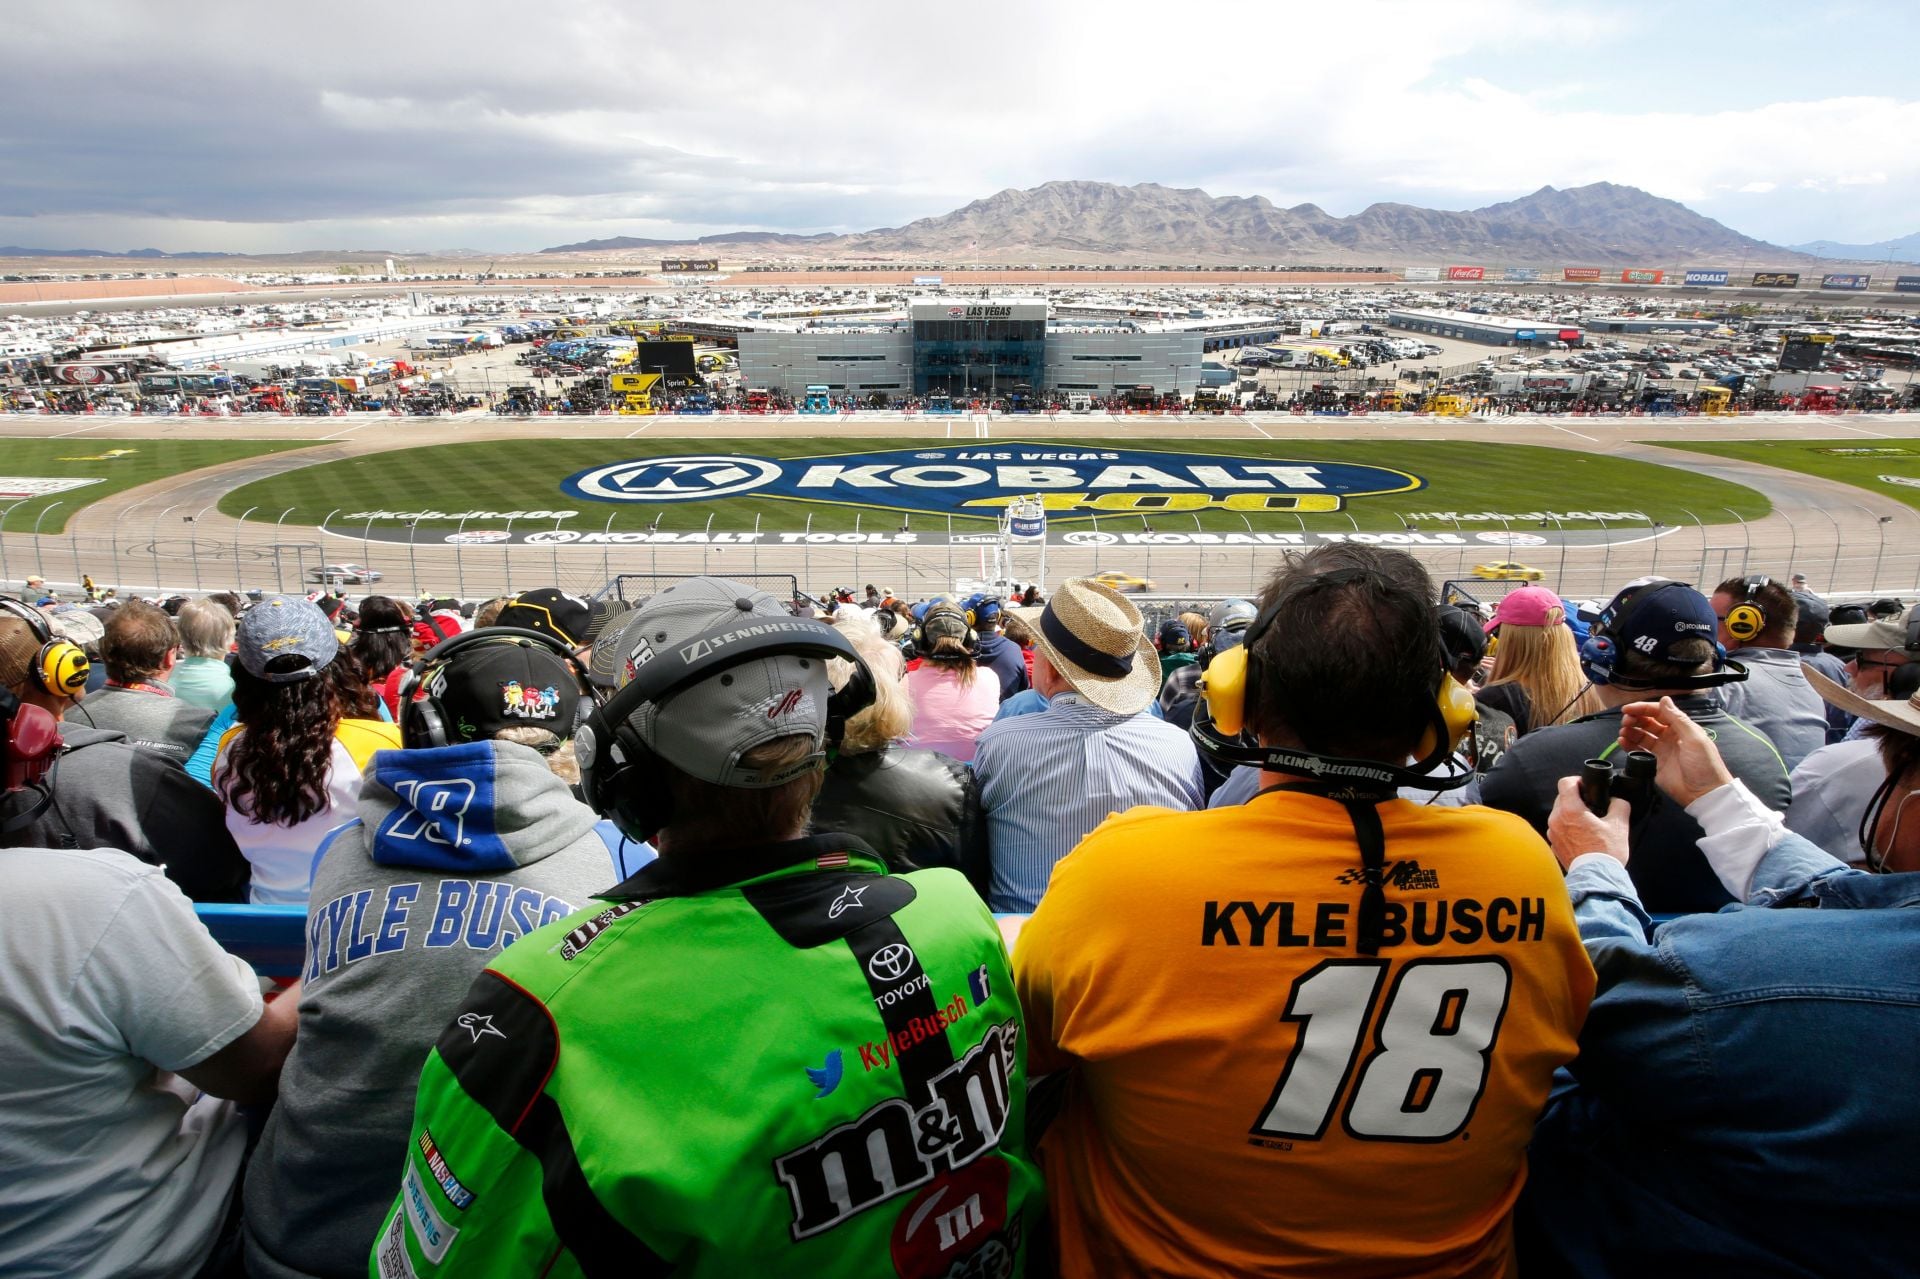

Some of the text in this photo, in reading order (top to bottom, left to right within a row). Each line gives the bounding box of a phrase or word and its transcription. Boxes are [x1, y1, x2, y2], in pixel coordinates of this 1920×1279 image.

[1685, 273, 1728, 282] KOBALT
[966, 307, 1012, 316] LAS VEGAS
[666, 379, 686, 388] Sprint
[956, 452, 1120, 460] LAS VEGAS
[797, 465, 1327, 489] KOBALT
[579, 532, 918, 544] KOBALT TOOLS
[1121, 532, 1305, 545] KOBALT
[1316, 532, 1467, 544] TOOLS
[711, 621, 828, 648] SENNHEISER
[1634, 635, 1658, 653] 48
[1267, 753, 1312, 770] RACING
[1319, 762, 1395, 783] ELECTRONICS
[1399, 882, 1440, 892] RACING
[303, 878, 579, 988] KYLE BUS
[1201, 897, 1546, 948] KYLE BUSCH
[874, 973, 933, 1011] TOYOTA
[858, 993, 969, 1073] KyleBusch
[1249, 955, 1513, 1144] 18
[428, 1152, 470, 1207] NASCAR
[408, 1173, 441, 1247] SIEMENS
